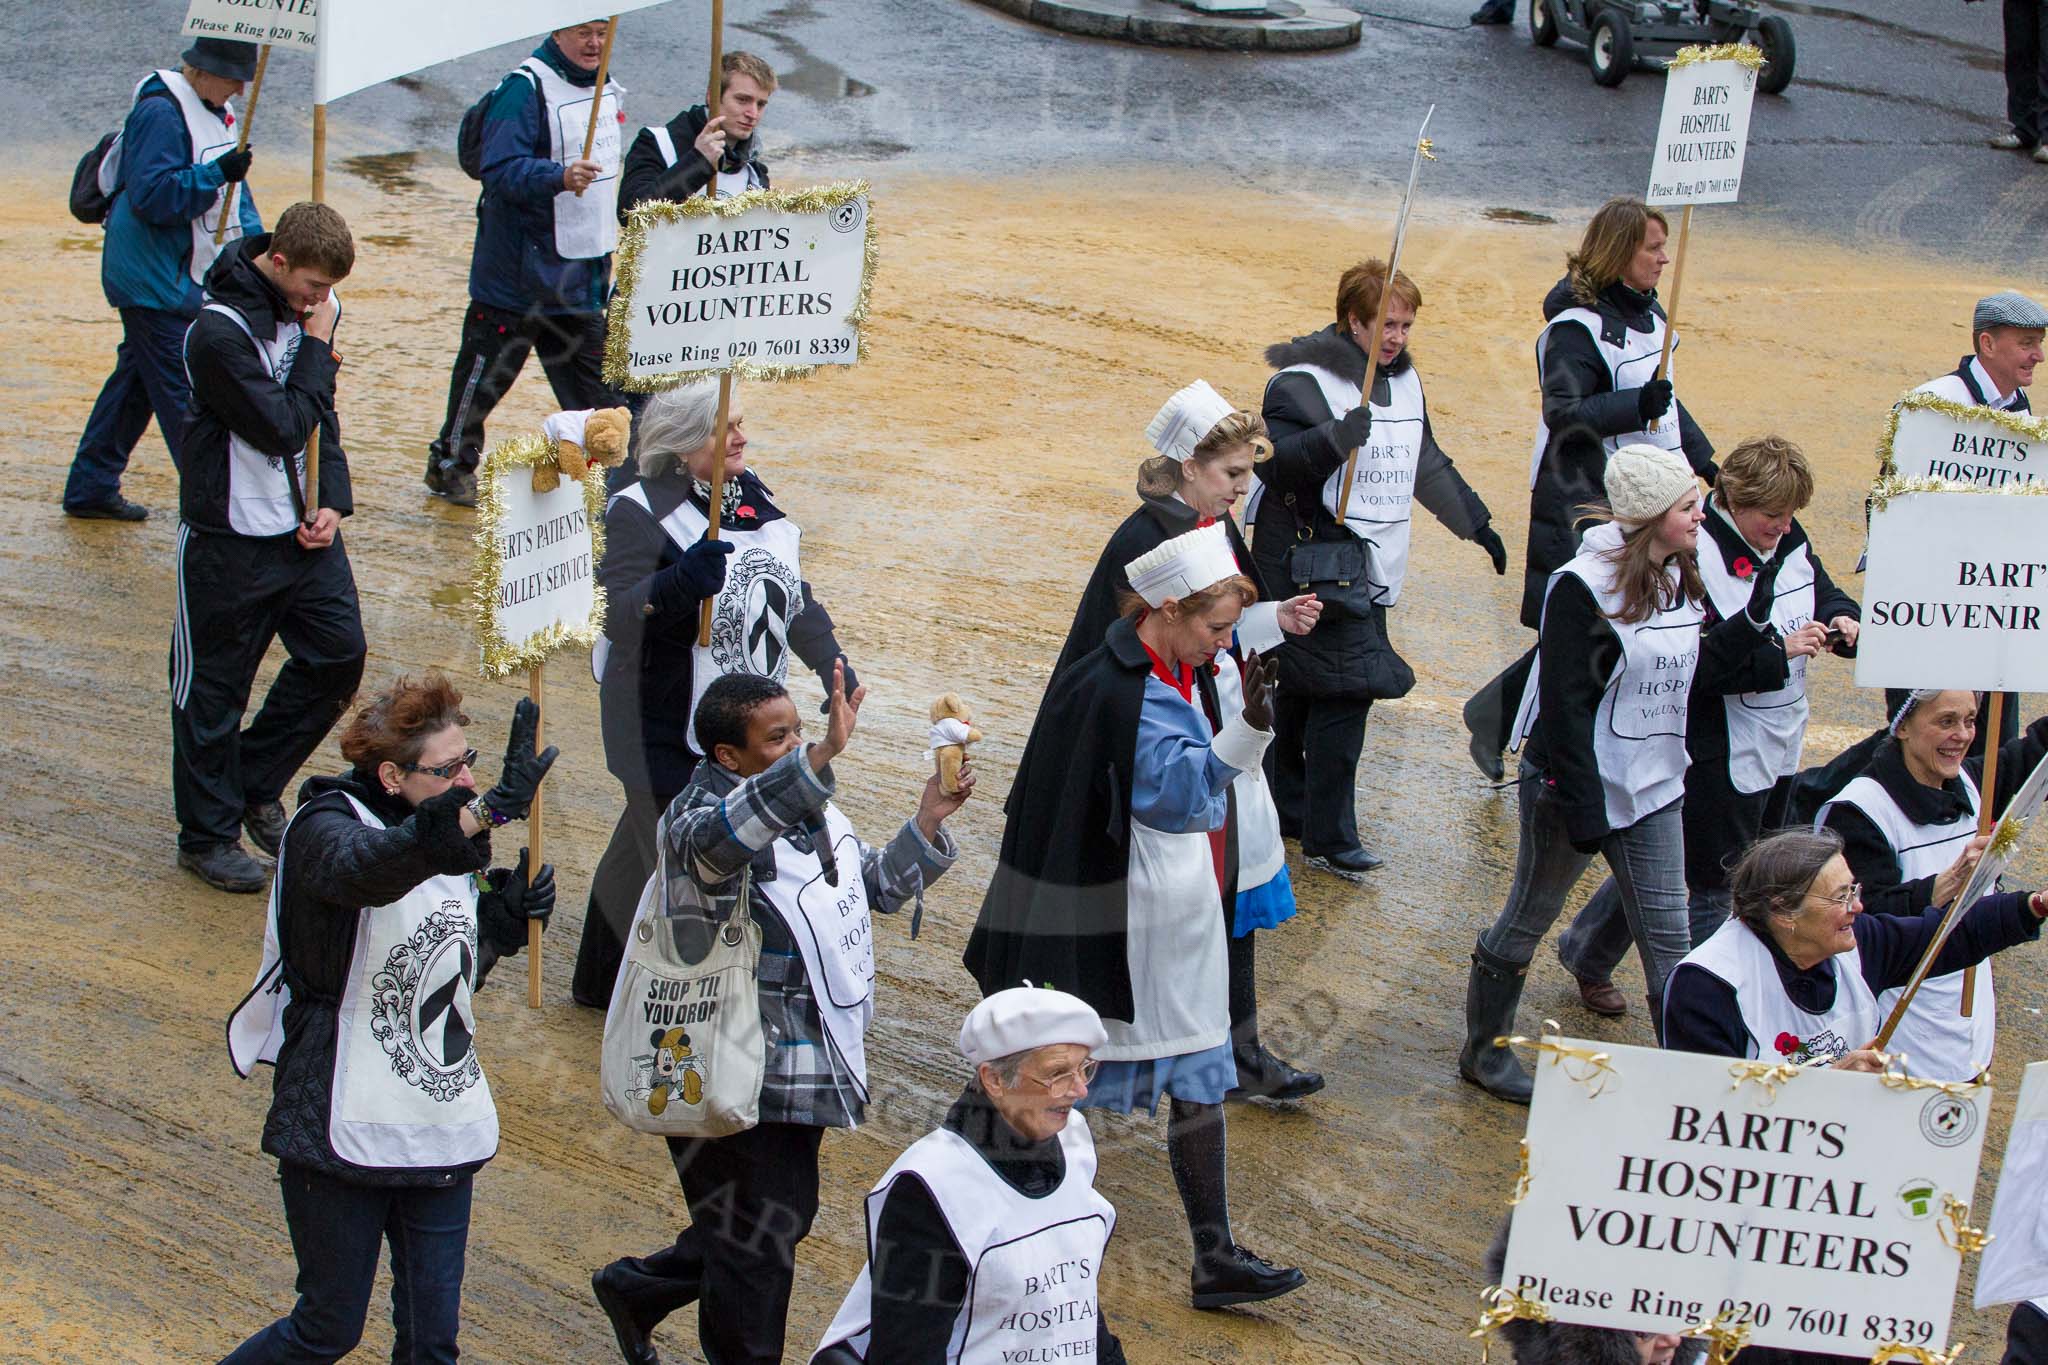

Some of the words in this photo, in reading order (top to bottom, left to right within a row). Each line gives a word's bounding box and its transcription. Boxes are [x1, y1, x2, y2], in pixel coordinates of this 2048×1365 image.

[190, 18, 229, 32] Please
[234, 22, 264, 38] Ring
[269, 26, 292, 40] 020
[1693, 86, 1730, 105] BART'S
[1680, 113, 1731, 134] HOSPITAL
[1667, 141, 1737, 163] VOLUNTEERS
[1651, 183, 1673, 197] Please
[1676, 182, 1693, 198] Ring
[1695, 181, 1707, 194] 020
[697, 227, 790, 256] BART'S
[671, 259, 810, 292] HOSPITAL
[646, 292, 833, 327] VOLUNTEERS
[681, 345, 720, 363] Ring
[728, 341, 757, 357] 020
[765, 339, 801, 356] 7601
[809, 337, 850, 354] 8339
[1952, 432, 2029, 462] BART'S
[547, 553, 589, 592] SERVICE
[1871, 600, 2041, 631] SOUVENIR
[648, 978, 691, 1001] SHOP
[643, 1001, 674, 1025] YOU
[675, 1001, 716, 1025] DROP
[1667, 1104, 1847, 1159] BART'S
[1617, 1155, 1877, 1218] HOSPITAL
[1567, 1205, 1911, 1278] VOLUNTEERS
[1025, 1258, 1090, 1296] BART'S
[1517, 1275, 1614, 1309] Please
[1630, 1288, 1702, 1323] Ring
[1718, 1299, 1771, 1328] 020
[1786, 1306, 1848, 1337] 7601
[1863, 1315, 1934, 1345] 8339
